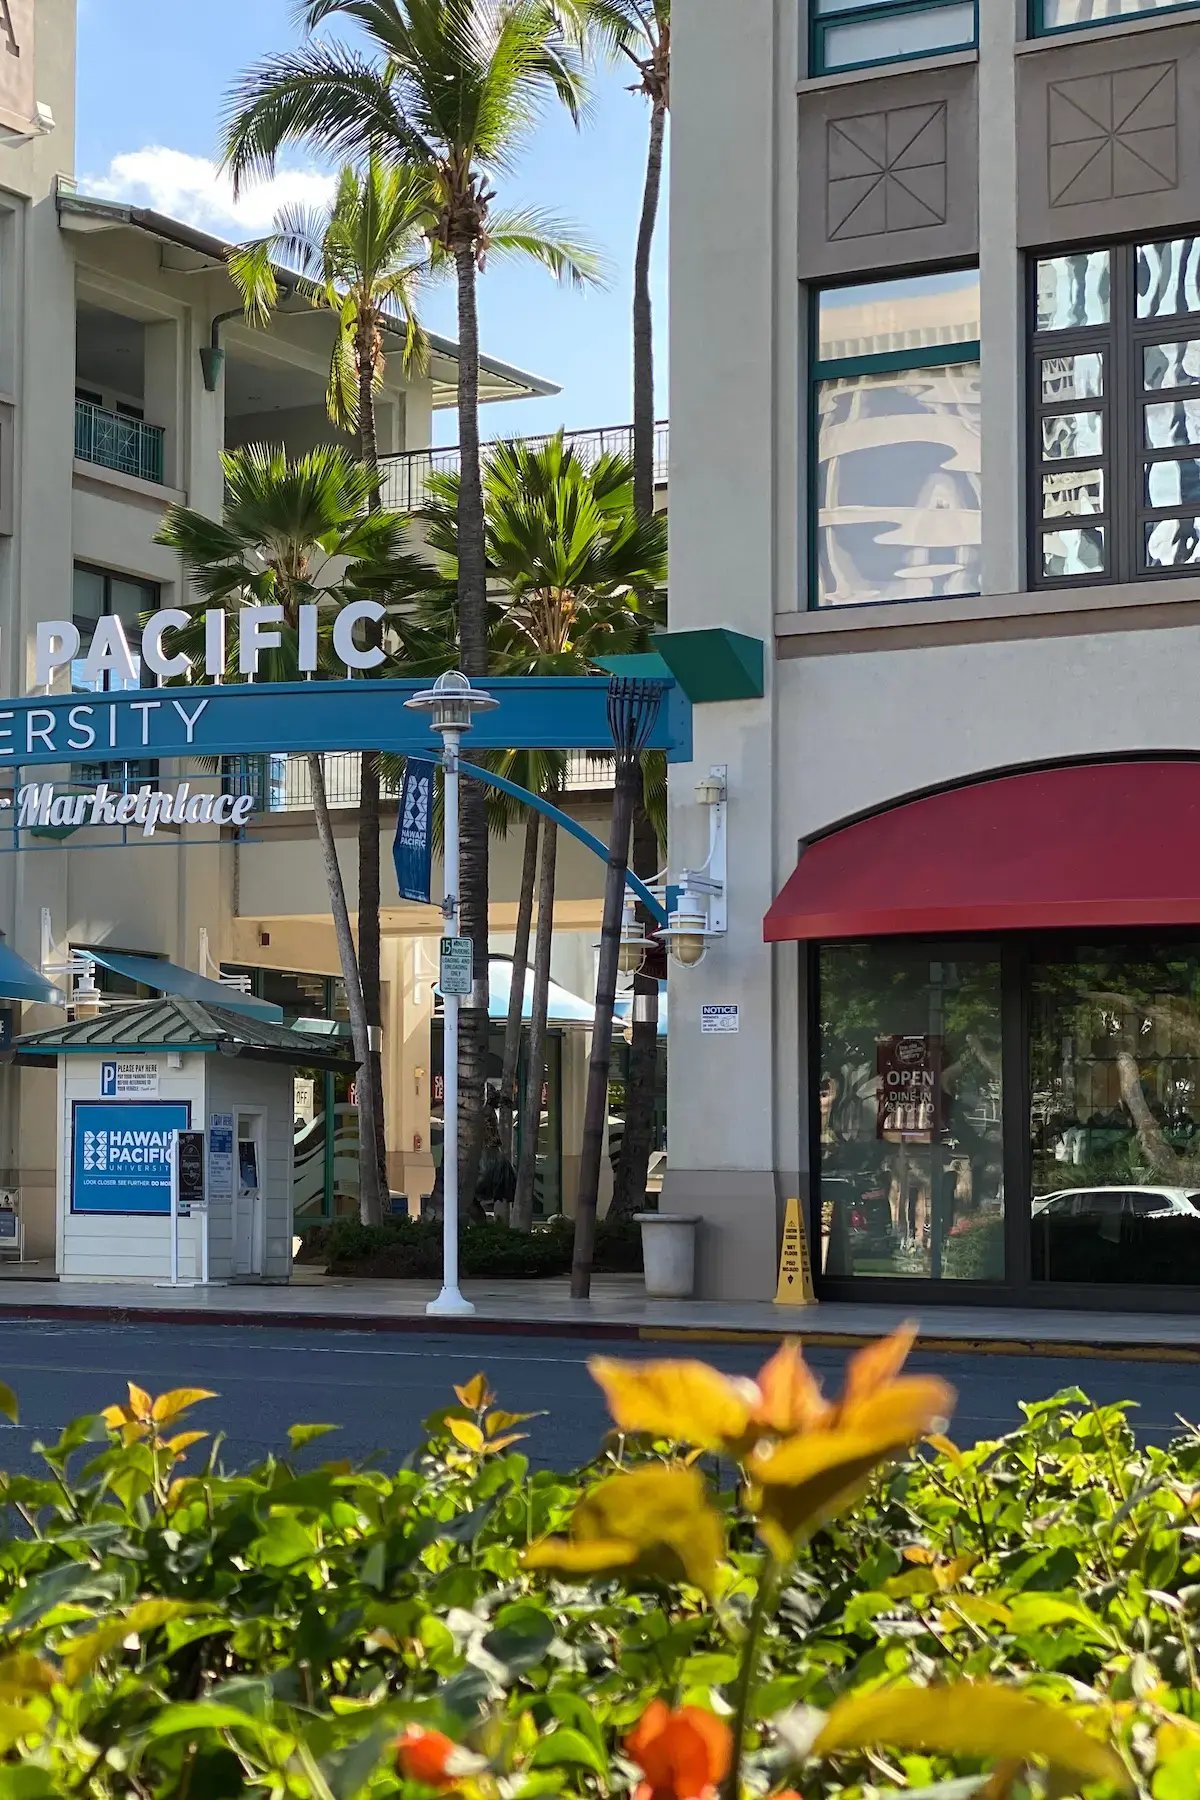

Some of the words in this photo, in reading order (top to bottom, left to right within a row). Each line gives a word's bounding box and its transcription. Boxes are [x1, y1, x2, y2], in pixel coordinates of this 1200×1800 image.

[35, 600, 387, 687] PACIFIC
[17, 782, 255, 837] Marketplace
[400, 837, 427, 848] PACIFIC
[441, 940, 451, 955] 15
[703, 1006, 737, 1014] NOTICE
[117, 1064, 135, 1072] PLEASE
[135, 1064, 144, 1072] PAY
[145, 1064, 158, 1072] HERE
[886, 1070, 935, 1086] OPEN
[296, 1091, 308, 1104] OFF
[109, 1164, 171, 1172] UNIVERSIT
